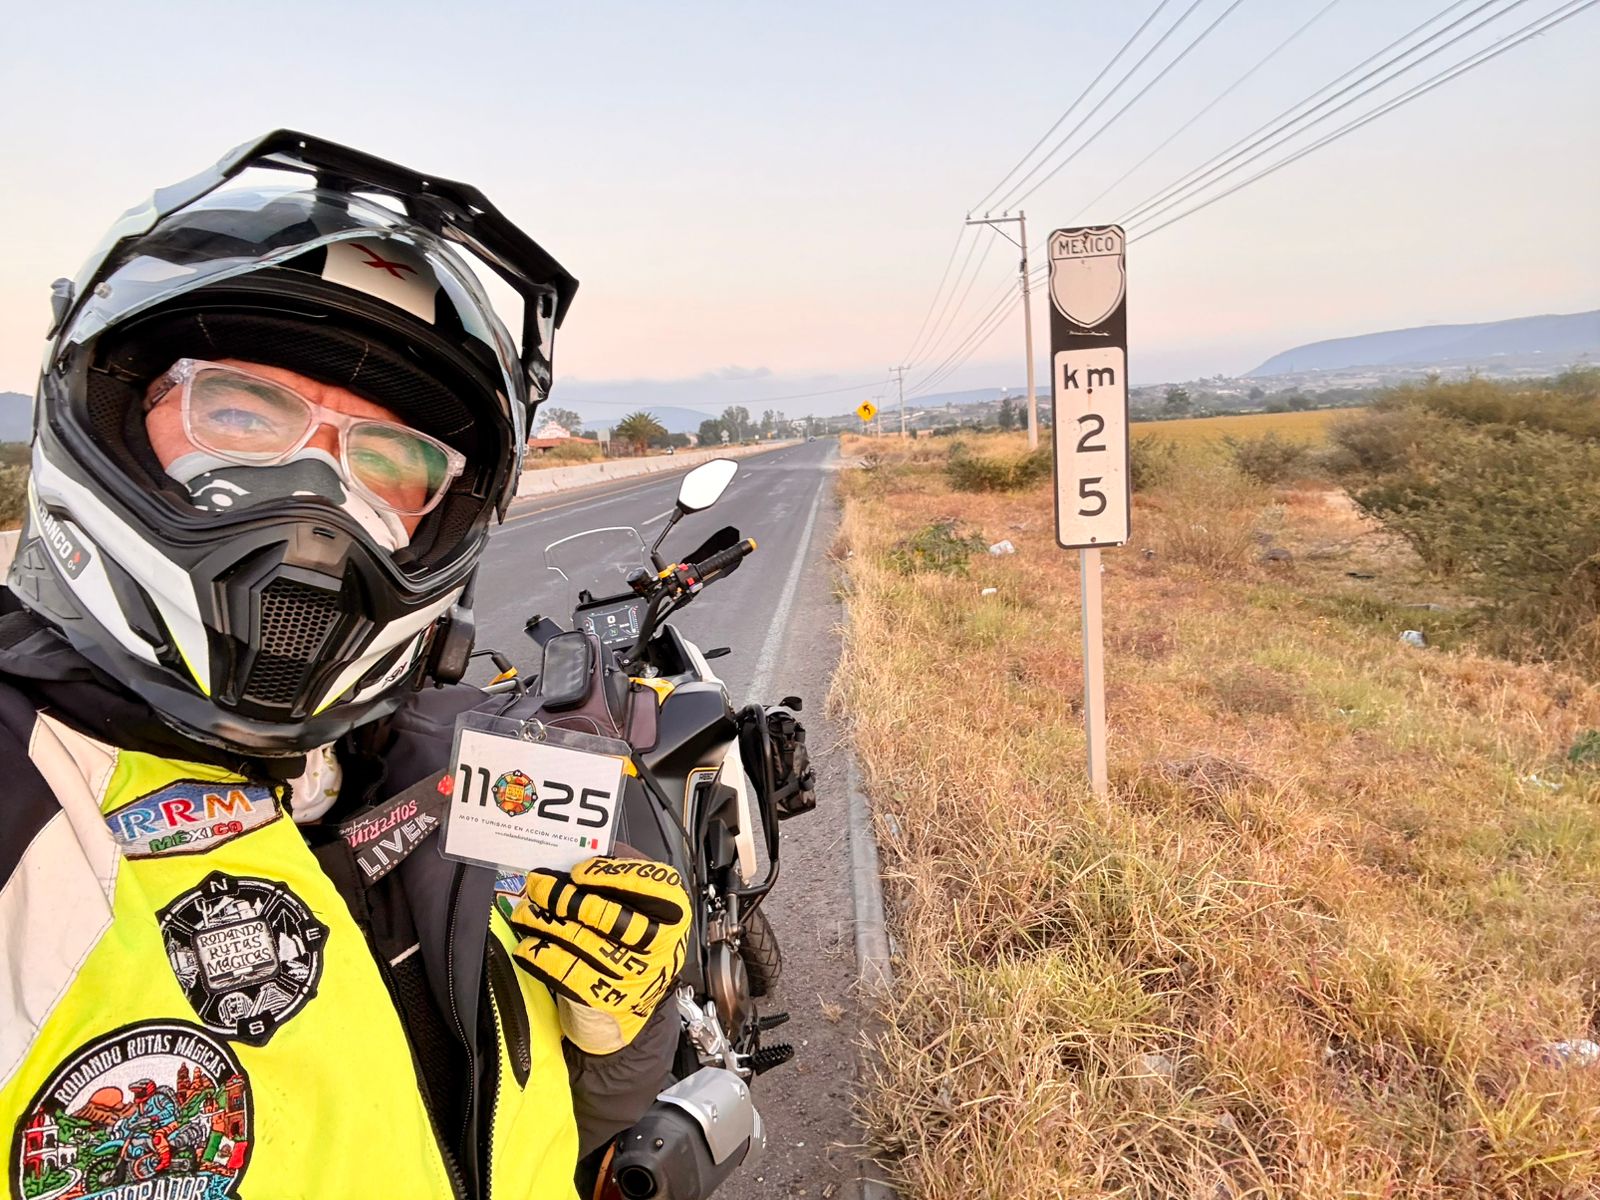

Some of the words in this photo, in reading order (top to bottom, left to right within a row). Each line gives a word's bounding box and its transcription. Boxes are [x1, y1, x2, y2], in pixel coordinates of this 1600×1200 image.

[1058, 236, 1114, 255] MEXICO
[1063, 363, 1115, 390] km
[1076, 413, 1107, 453] 2
[1078, 476, 1107, 517] 5
[117, 789, 256, 842] RRM
[458, 814, 479, 823] MOTO
[481, 818, 512, 830] TURISMO
[210, 878, 228, 893] N
[306, 927, 321, 942] E
[248, 1020, 265, 1035] S
[54, 1045, 122, 1106] RODANDO
[127, 1034, 172, 1059] RUTAS
[173, 1036, 226, 1079] MÁGICAS
